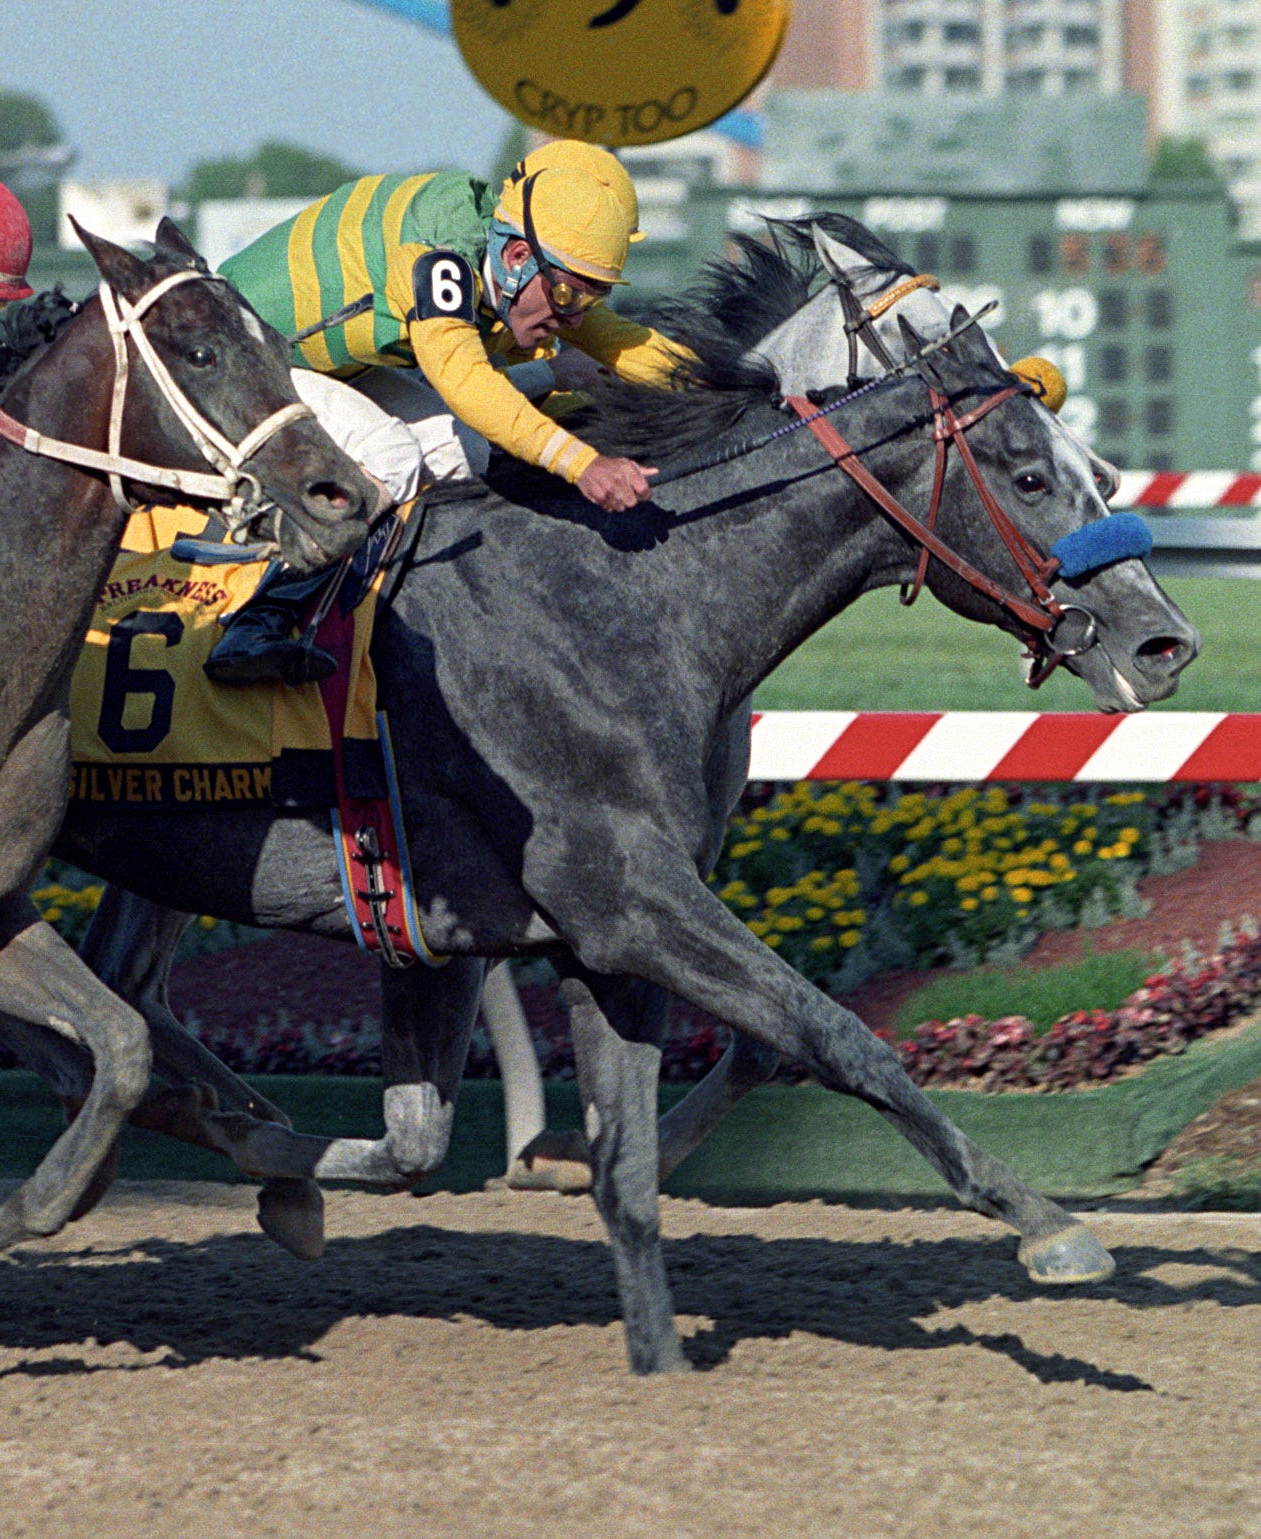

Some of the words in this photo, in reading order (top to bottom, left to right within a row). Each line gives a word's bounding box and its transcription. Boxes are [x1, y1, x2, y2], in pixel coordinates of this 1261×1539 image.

[432, 260, 462, 311] 6
[1034, 286, 1098, 338] 10
[98, 610, 184, 753] 6
[172, 766, 272, 802] CHARM
